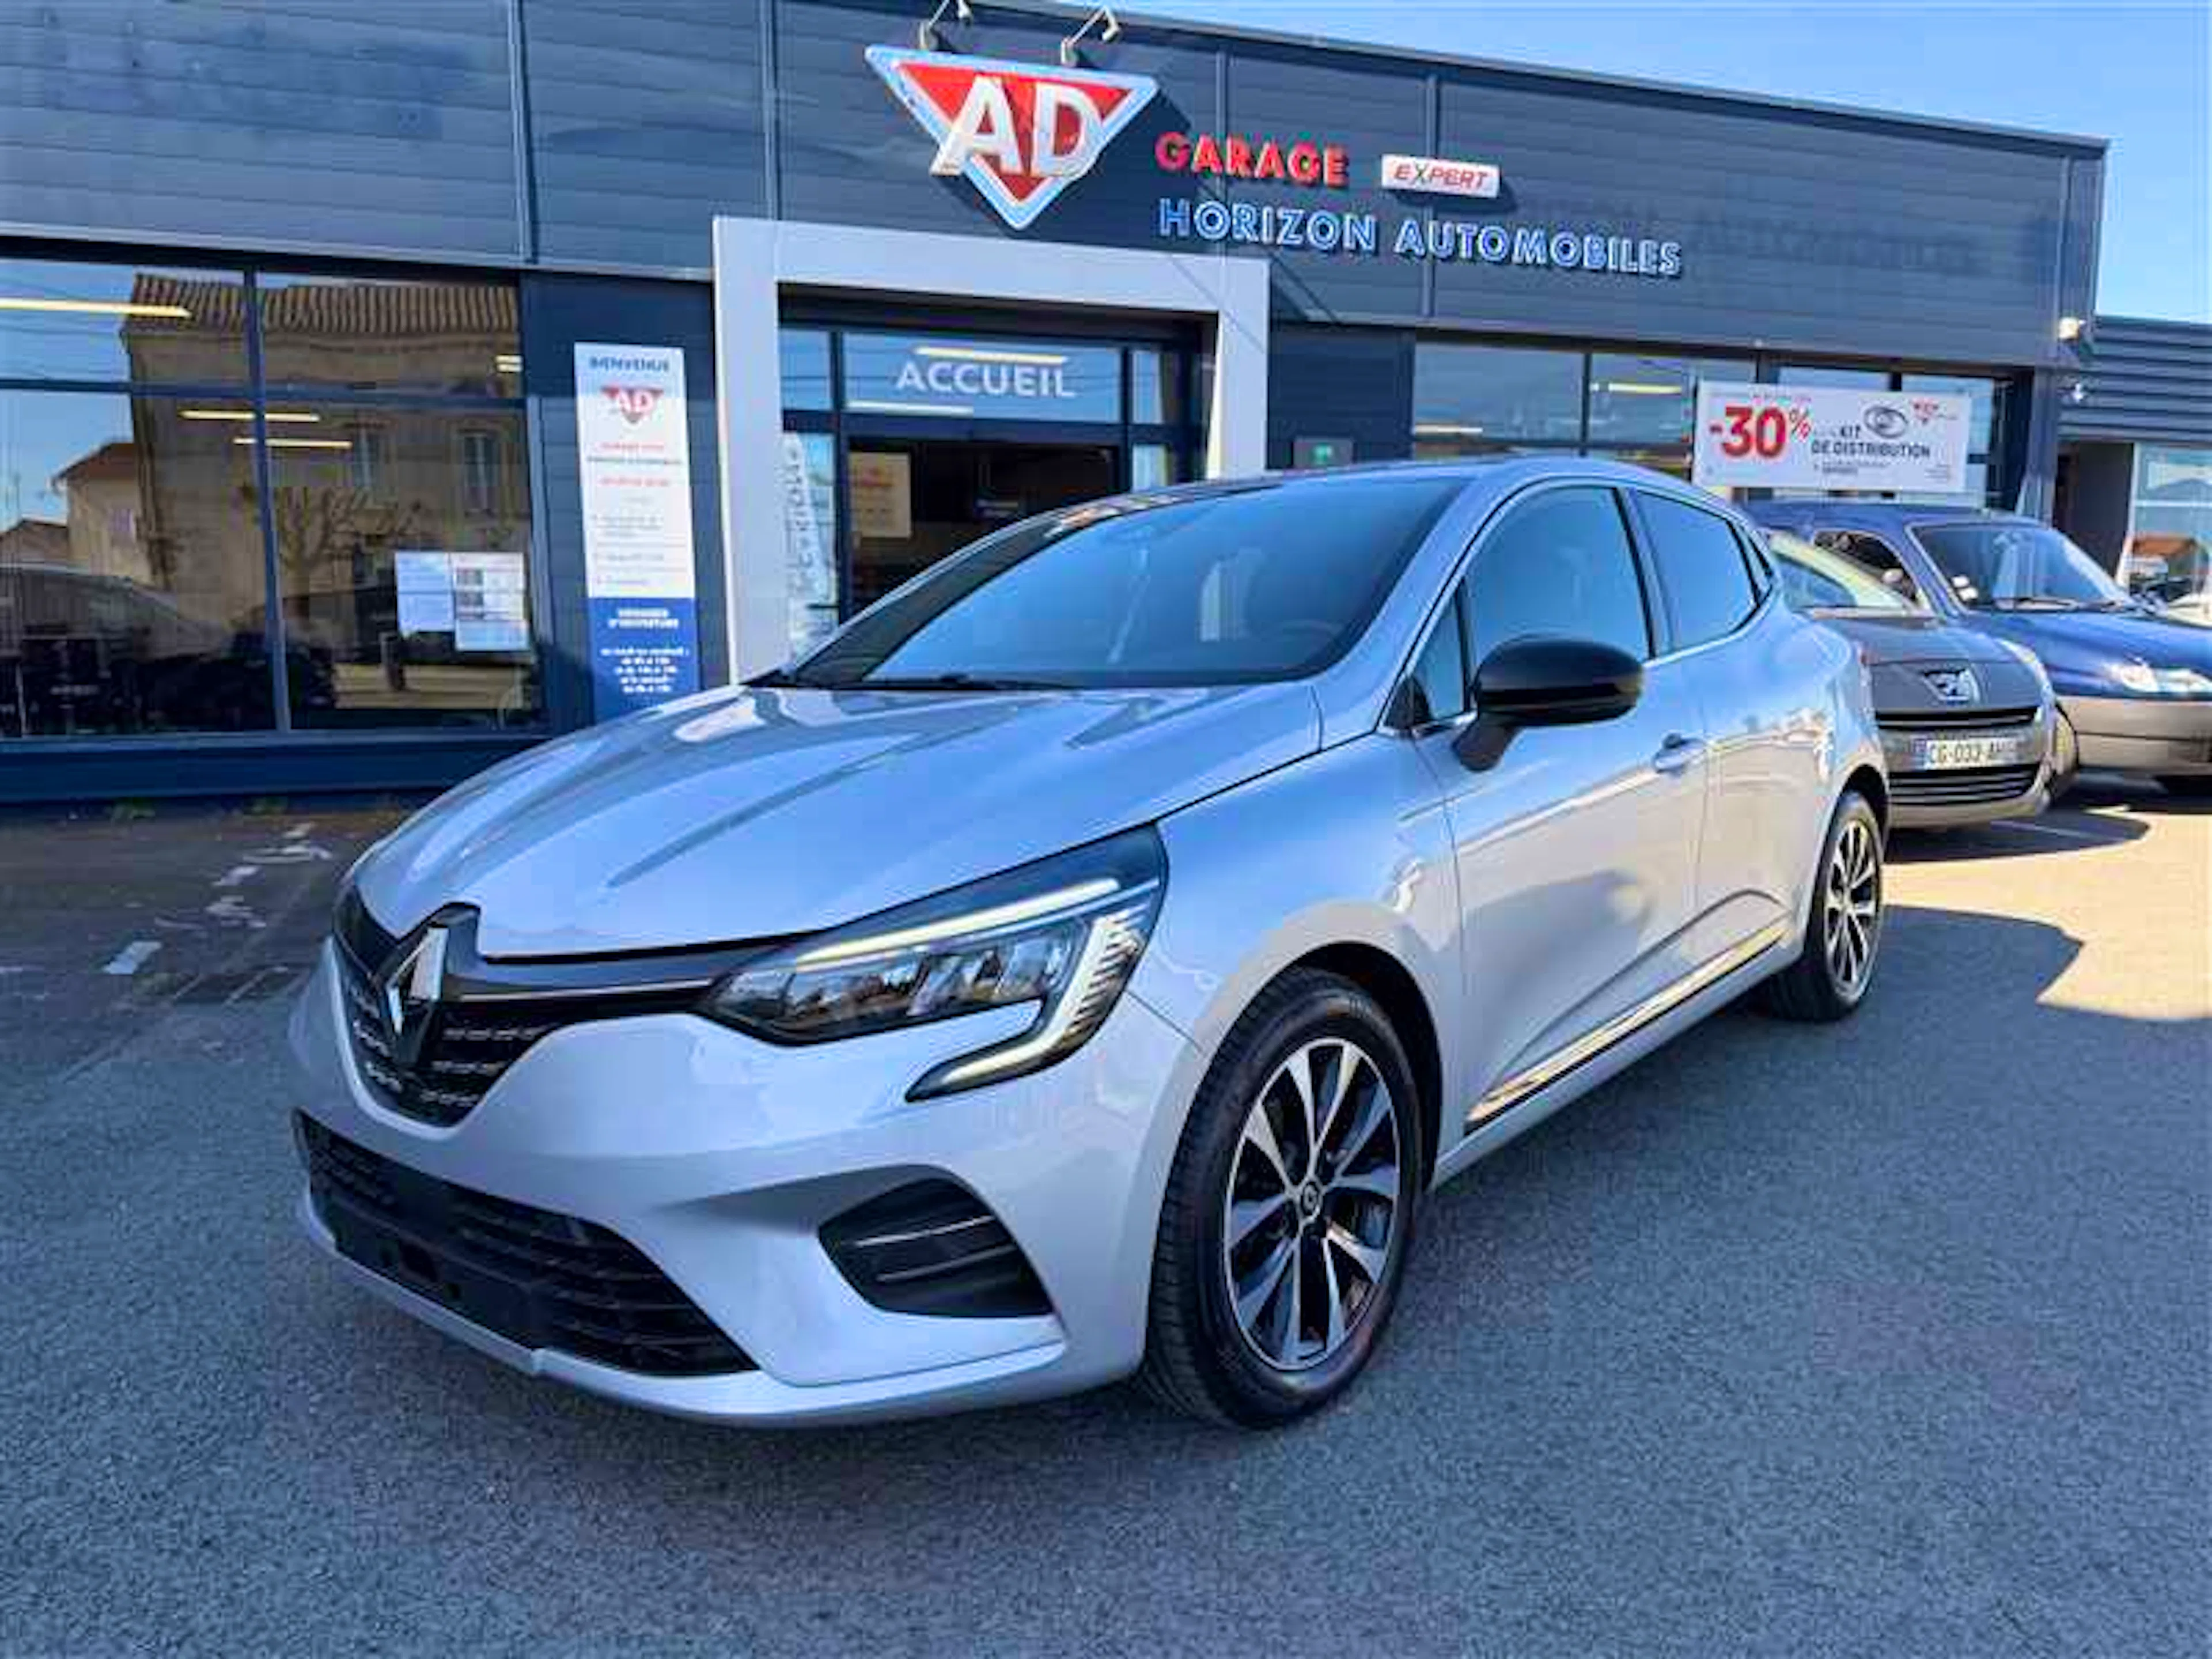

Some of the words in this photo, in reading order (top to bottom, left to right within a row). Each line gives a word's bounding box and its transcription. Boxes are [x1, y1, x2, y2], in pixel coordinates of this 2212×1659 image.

[929, 75, 1103, 176] AD
[1154, 131, 1350, 187] GARAGE
[1393, 163, 1490, 191] EXPERT
[1158, 197, 1378, 252] HORIZON
[1393, 219, 1683, 276] AUTOMOBILES
[896, 361, 1076, 399] ACCUEIL
[1709, 405, 1813, 459] -30%
[1834, 441, 1931, 459] DISTRIBUTION
